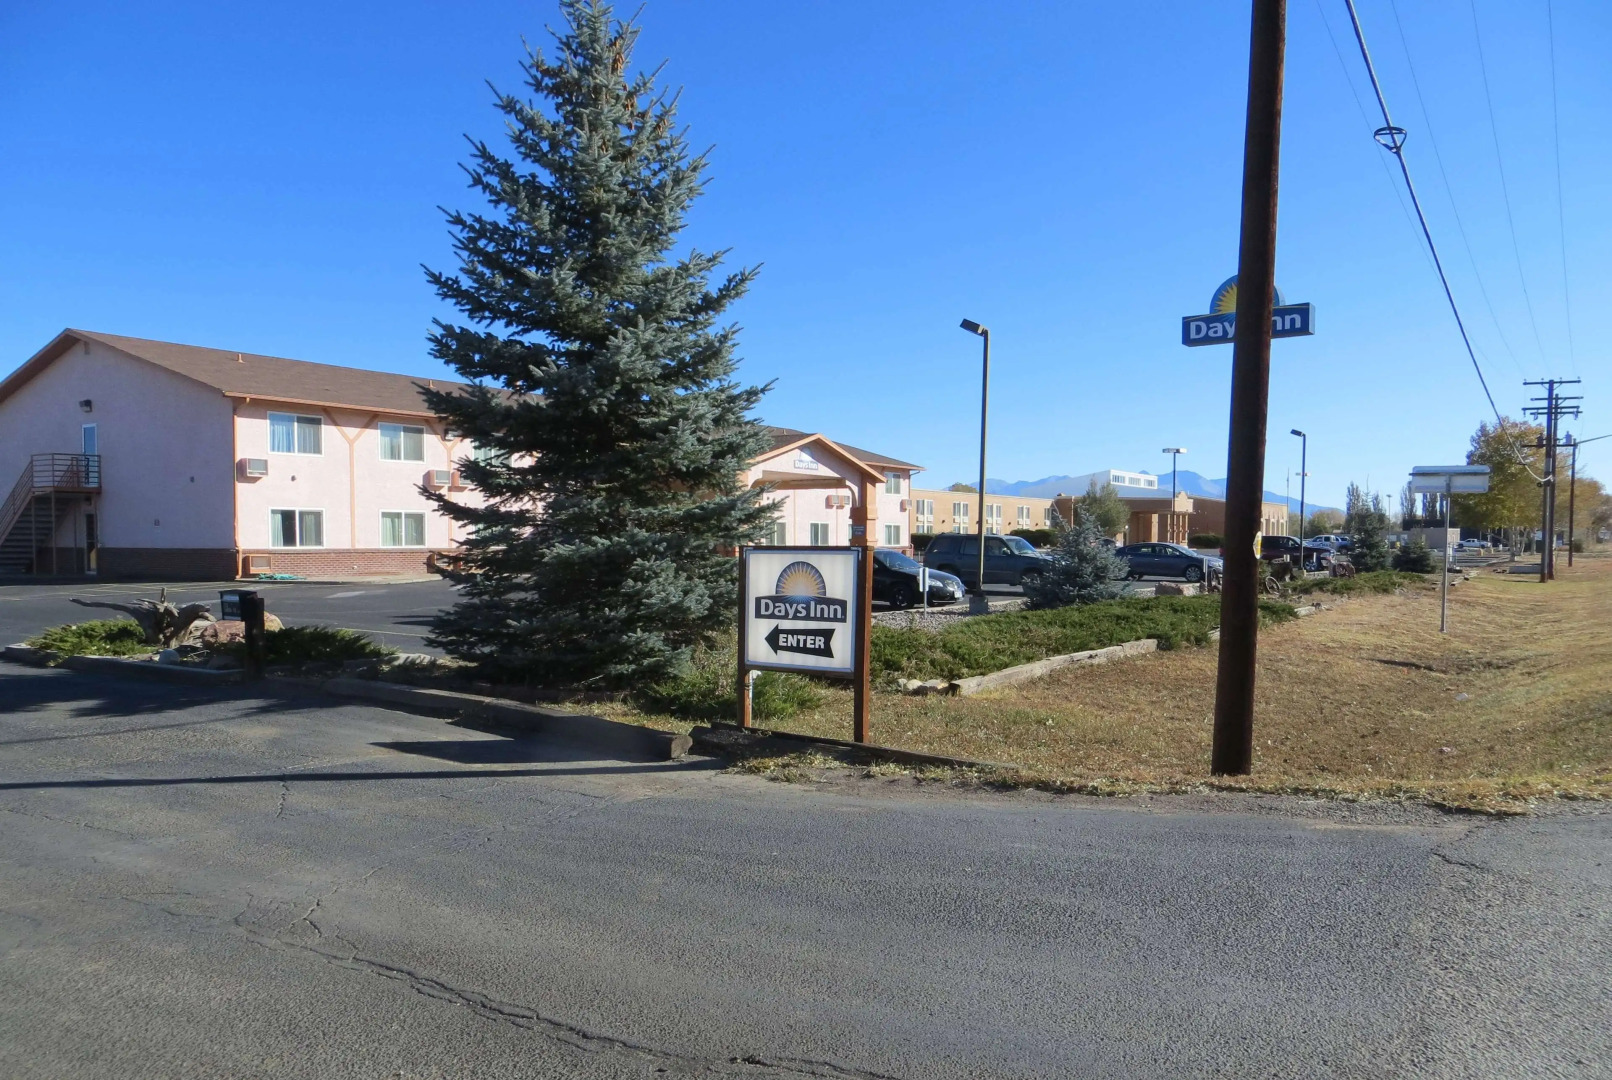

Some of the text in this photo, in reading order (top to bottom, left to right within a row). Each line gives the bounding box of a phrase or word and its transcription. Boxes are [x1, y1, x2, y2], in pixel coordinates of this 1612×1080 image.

[1190, 313, 1302, 340] Day nn
[760, 599, 842, 619] Days Inn
[778, 633, 825, 649] ENTER
